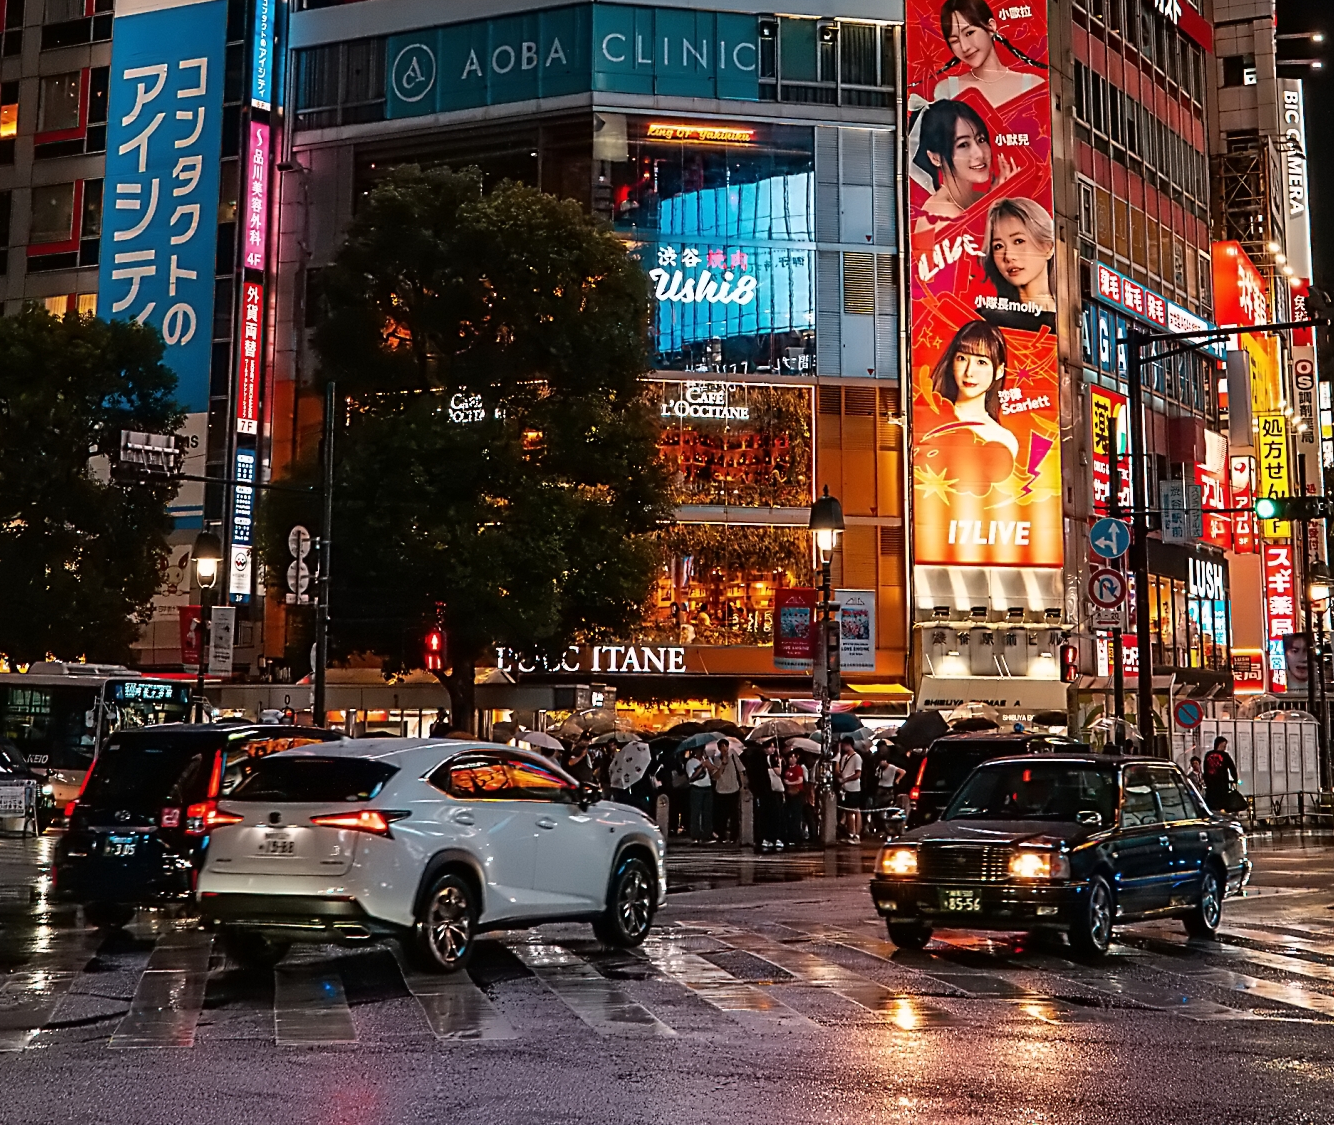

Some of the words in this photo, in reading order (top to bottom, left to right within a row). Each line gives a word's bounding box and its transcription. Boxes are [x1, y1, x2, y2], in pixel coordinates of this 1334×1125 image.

[461, 37, 567, 80] AOBA
[601, 33, 757, 72] CLINIC
[1282, 90, 1300, 125] BIC
[163, 57, 208, 346] コンタクトの
[249, 148, 265, 246] 品川美容外科
[246, 253, 262, 266] 4F
[657, 246, 703, 268] 渋谷
[706, 249, 748, 271] 焼肉
[918, 233, 986, 281] LIVE
[649, 266, 758, 305] Ushi8
[244, 286, 260, 358] 外貨両替
[1294, 359, 1315, 390] OS
[1001, 395, 1051, 416] Scarlett
[240, 421, 254, 432] 7F
[1261, 418, 1286, 499] 処方せん
[1188, 557, 1225, 601] LUSH
[1267, 549, 1295, 641] スギ薬局
[27, 754, 49, 764] KEIO
